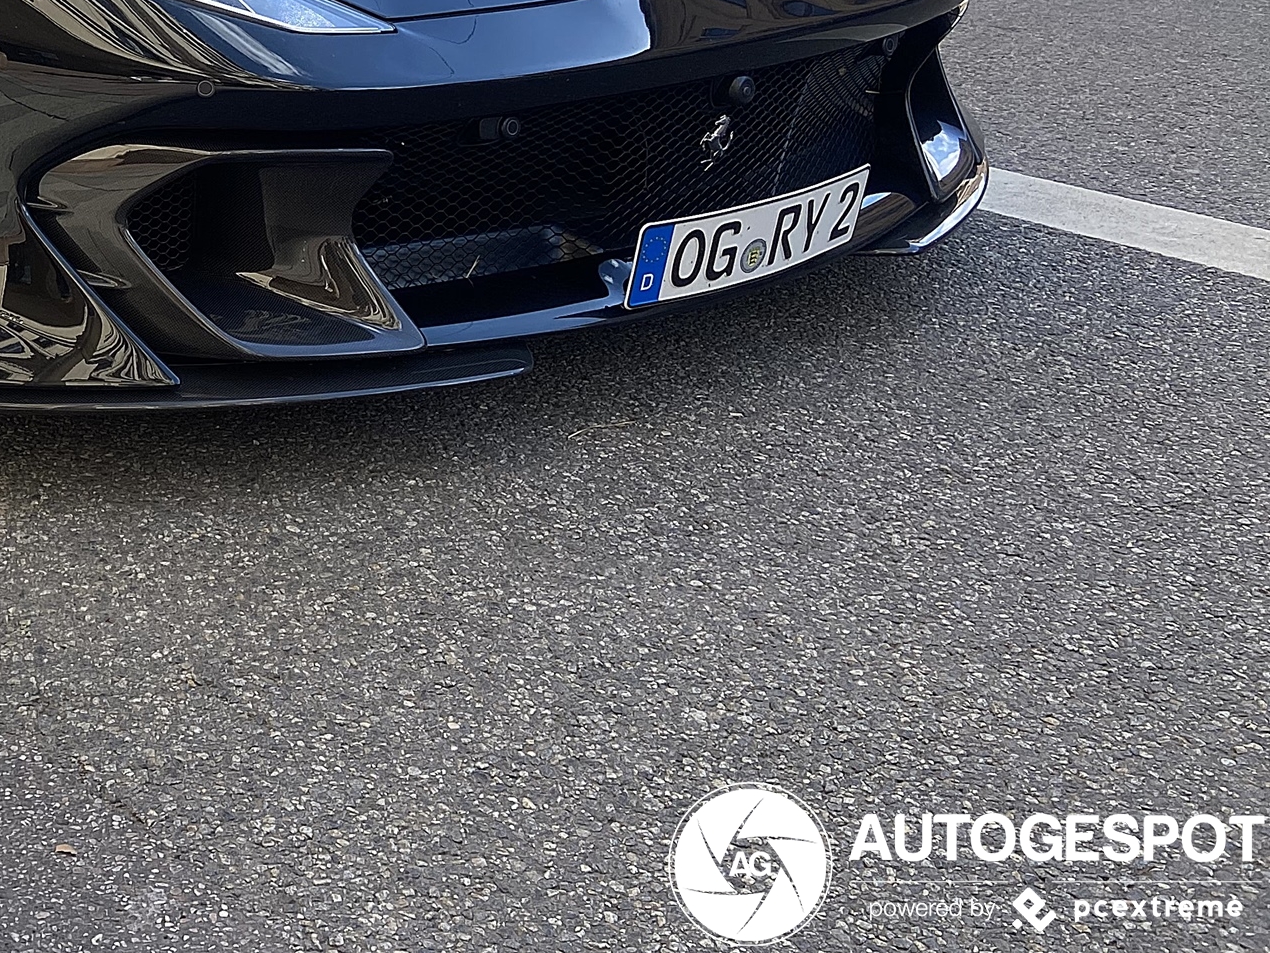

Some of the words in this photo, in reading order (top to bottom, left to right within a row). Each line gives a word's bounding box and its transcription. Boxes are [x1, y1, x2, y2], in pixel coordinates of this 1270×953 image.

[640, 273, 654, 291] D
[671, 221, 742, 288] OG
[767, 193, 831, 266] RY
[829, 182, 860, 242] 2
